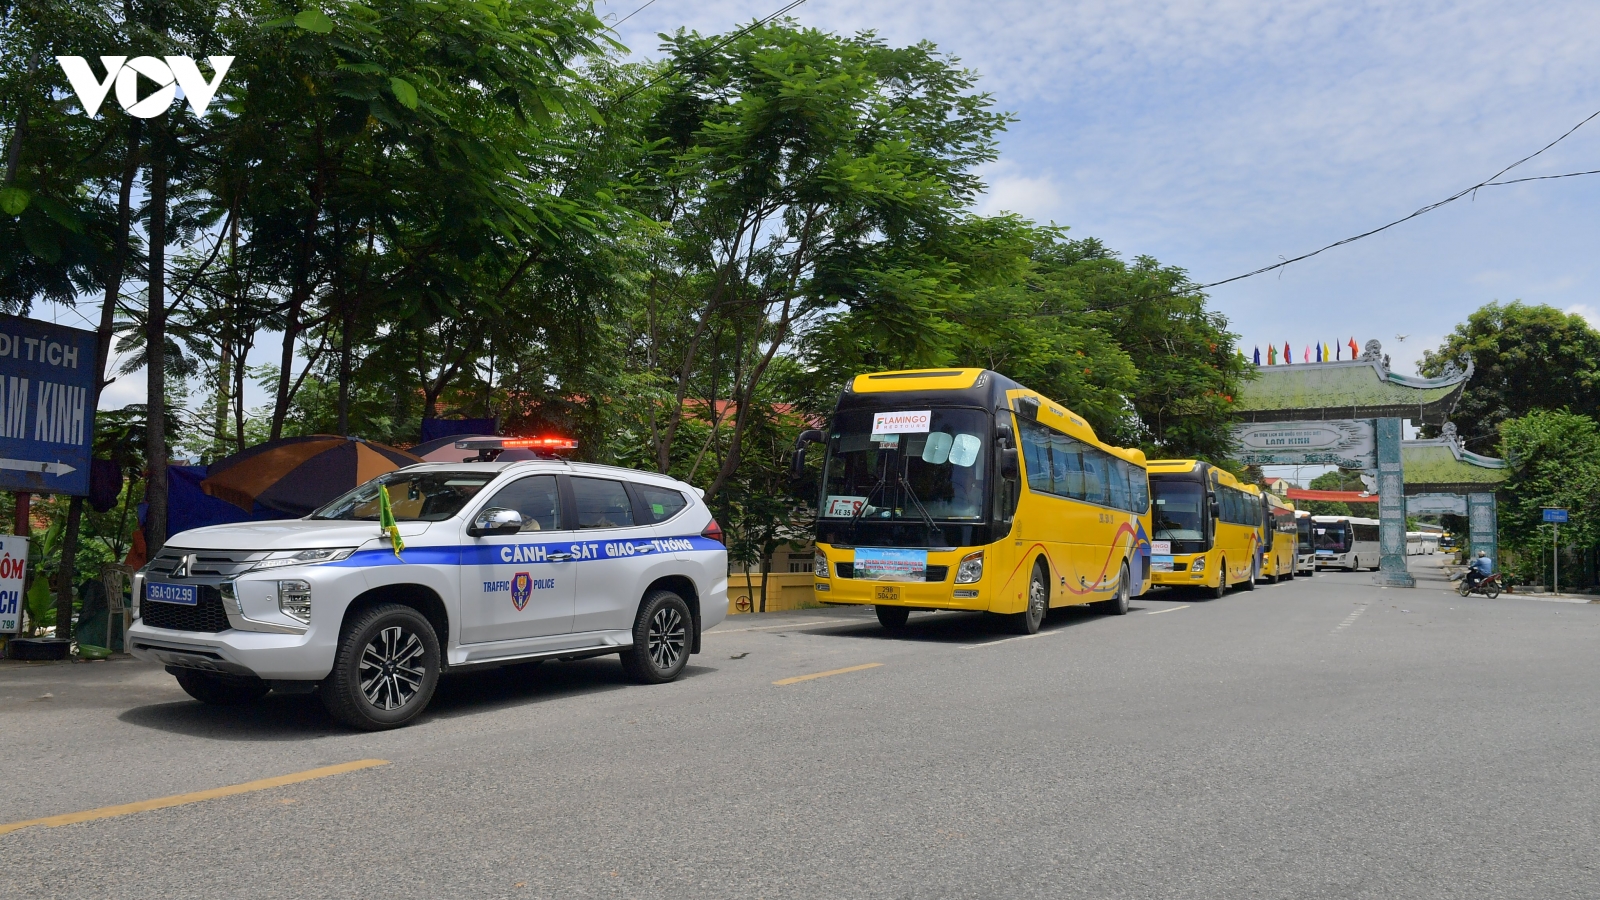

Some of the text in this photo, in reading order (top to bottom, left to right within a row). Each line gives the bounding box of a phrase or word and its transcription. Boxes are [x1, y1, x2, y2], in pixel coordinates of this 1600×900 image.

[25, 335, 78, 369] TÍCH
[35, 381, 86, 445] KINH
[876, 416, 926, 429] FLAMINGO
[501, 538, 693, 562] CẢNH SÁT GIAO THÔNG
[150, 585, 193, 601] 36A-012.99
[483, 578, 555, 592] TRAFFIC POLICE
[2, 620, 15, 629] 798
